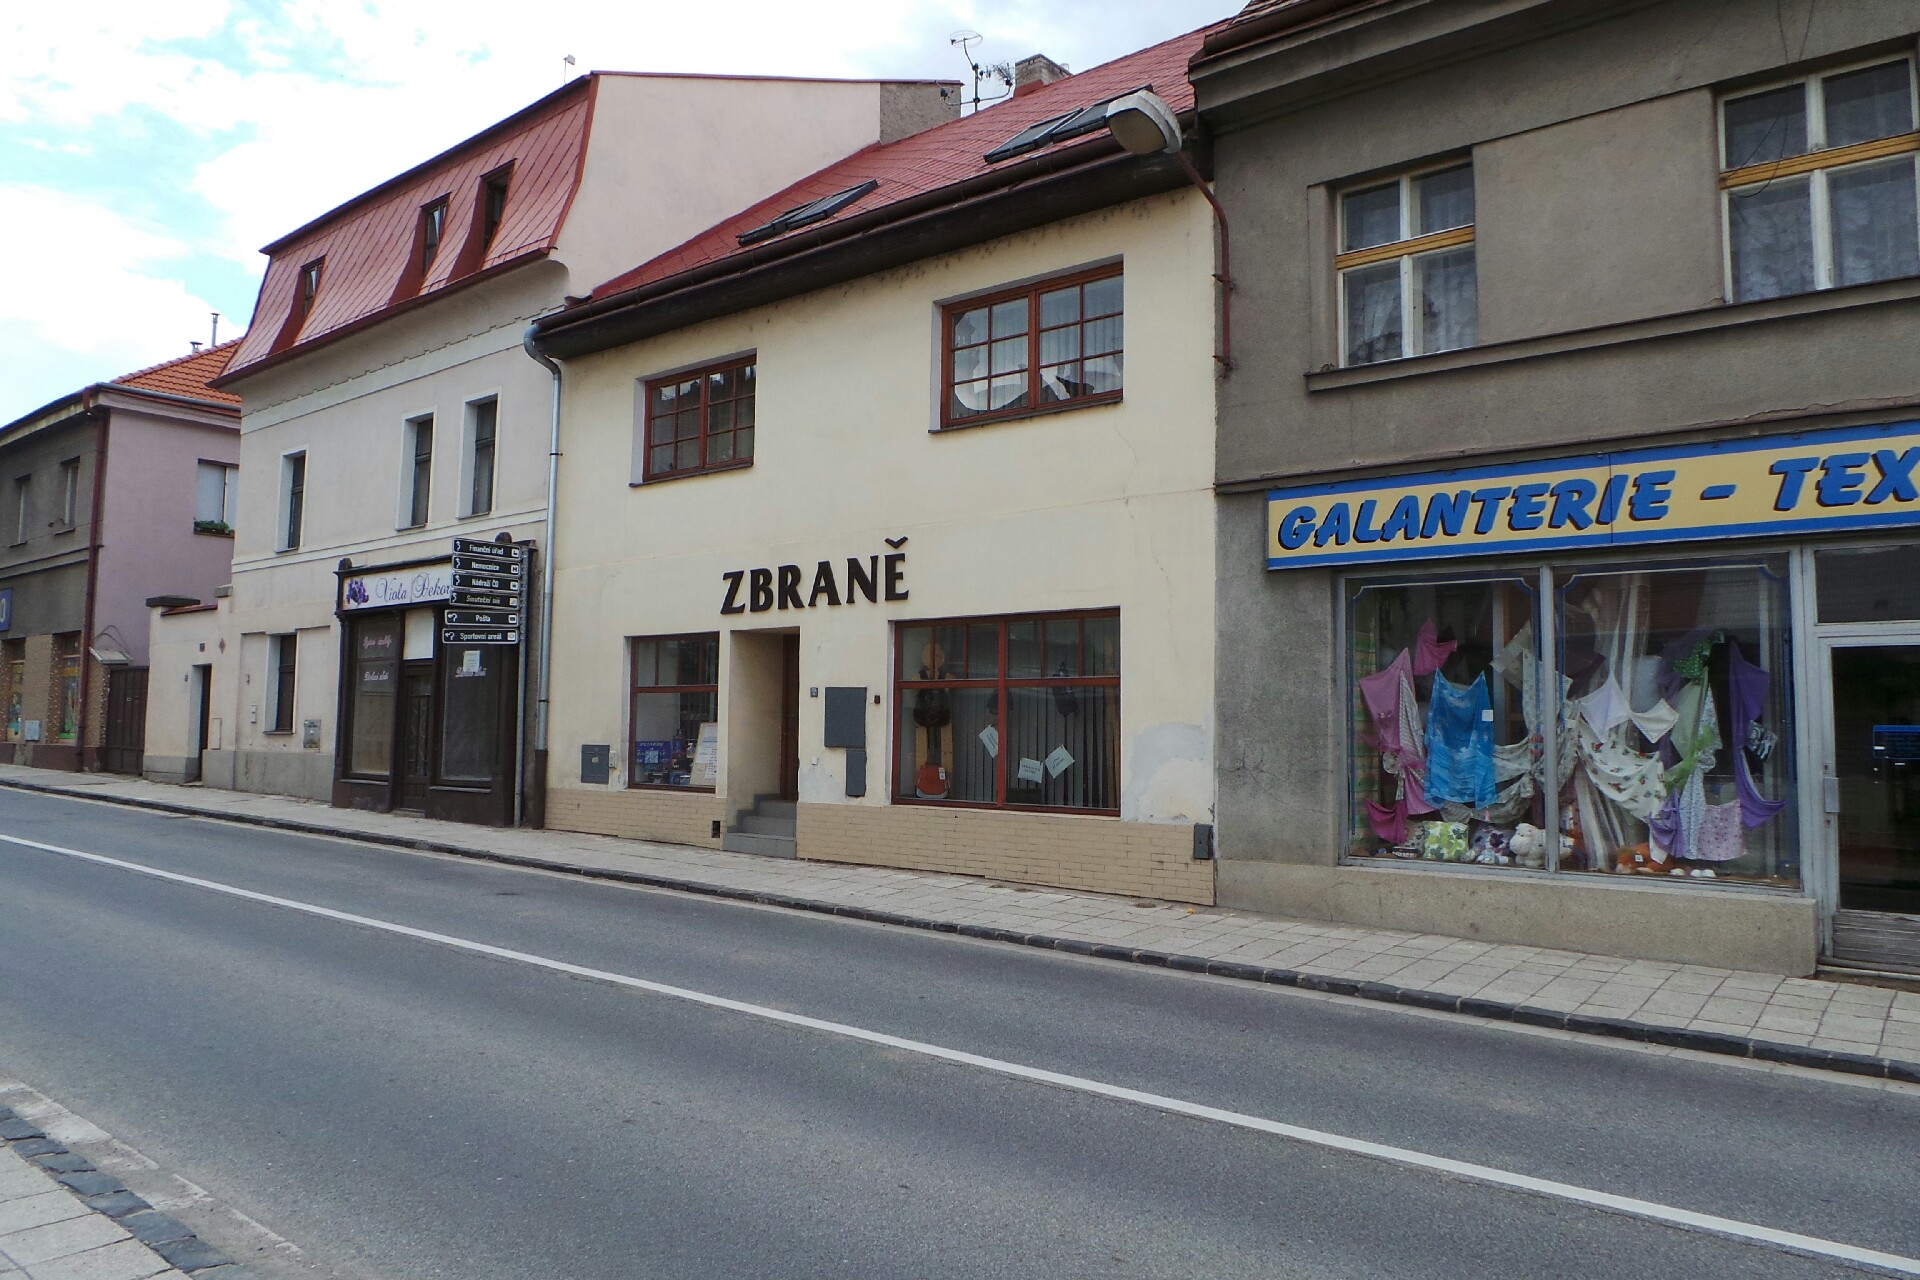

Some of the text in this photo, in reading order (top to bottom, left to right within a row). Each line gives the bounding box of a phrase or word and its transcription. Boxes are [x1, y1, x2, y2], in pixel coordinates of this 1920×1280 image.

[1278, 446, 1920, 550] GALANTERIE - TEX
[469, 544, 491, 554] Finanční
[471, 561, 500, 571] Nemocnice
[720, 536, 909, 615] ZBRANĚ
[471, 578, 491, 587] Nádraží
[375, 577, 407, 602] Viola
[475, 614, 491, 622] Pošta
[459, 632, 487, 641] Sportovní
